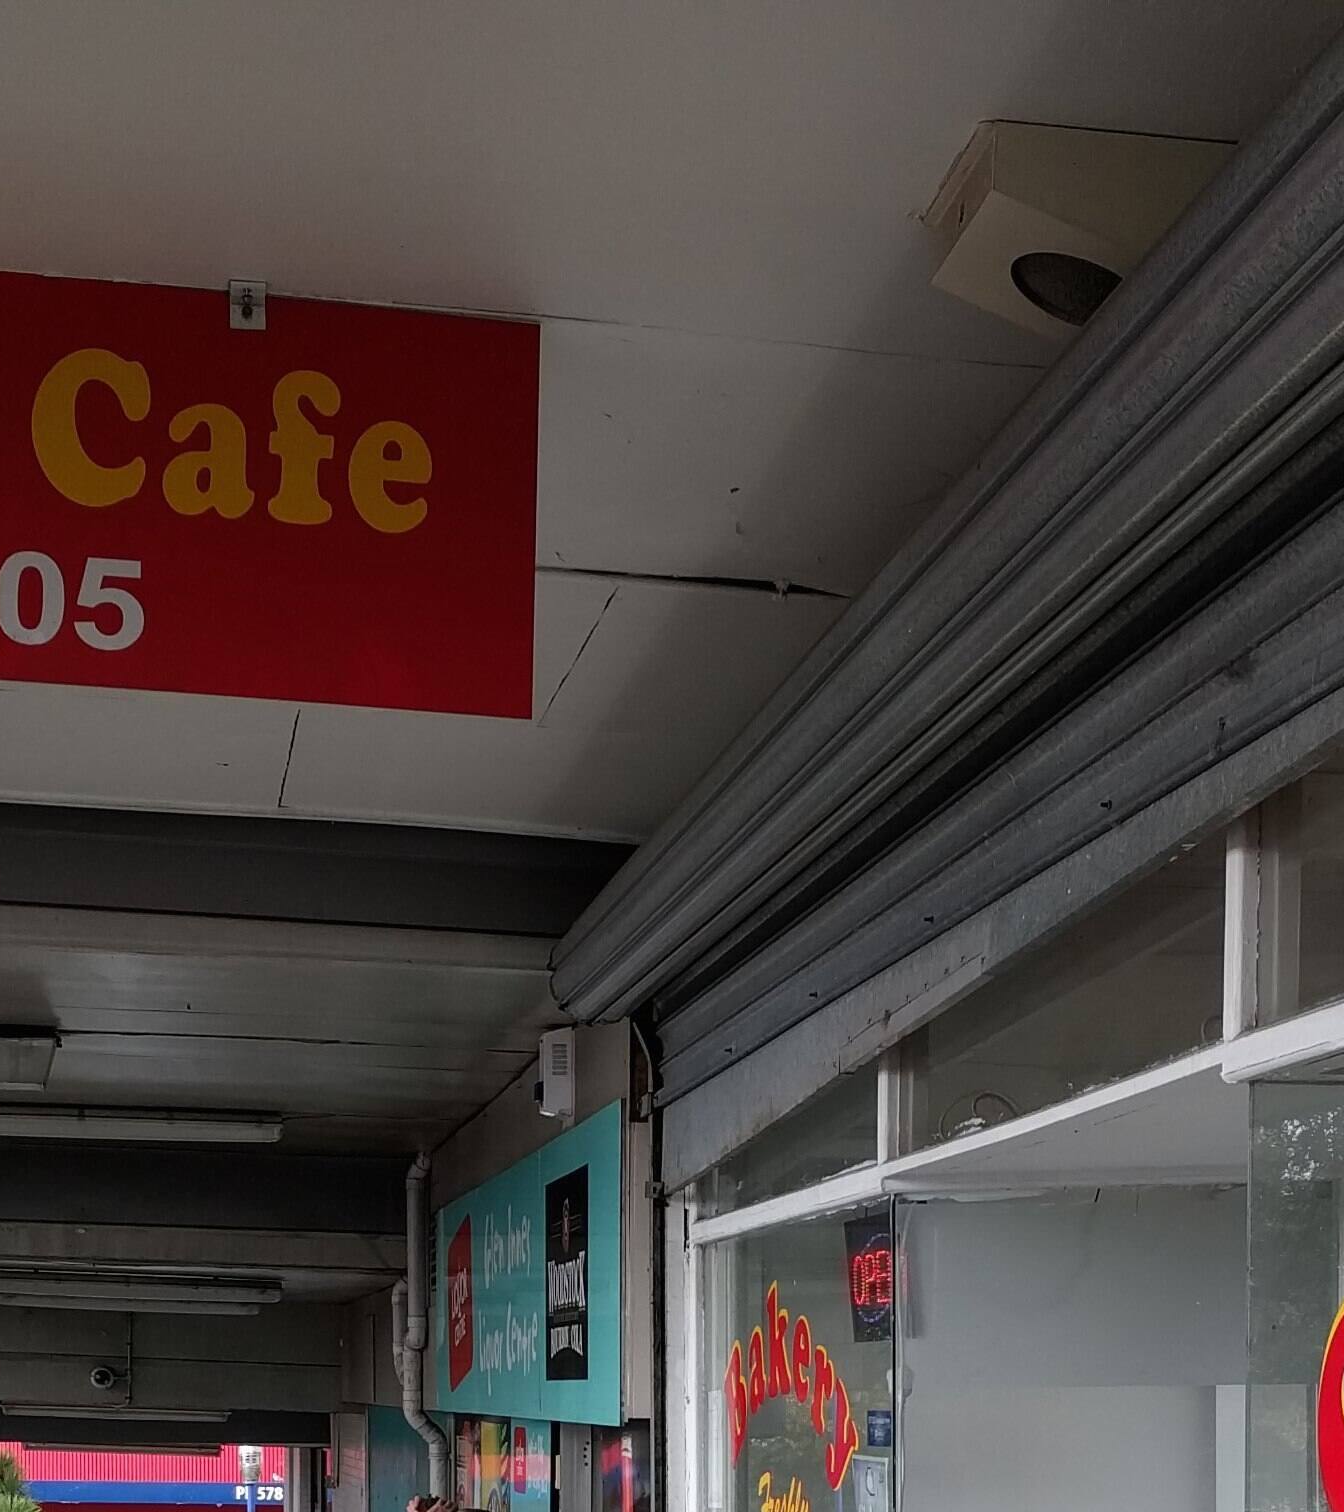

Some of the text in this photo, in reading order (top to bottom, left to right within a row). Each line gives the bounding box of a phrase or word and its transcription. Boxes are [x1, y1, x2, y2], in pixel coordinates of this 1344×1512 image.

[30, 346, 435, 535] Cafe
[484, 1211, 504, 1290] Glen
[723, 1278, 859, 1492] Bakery
